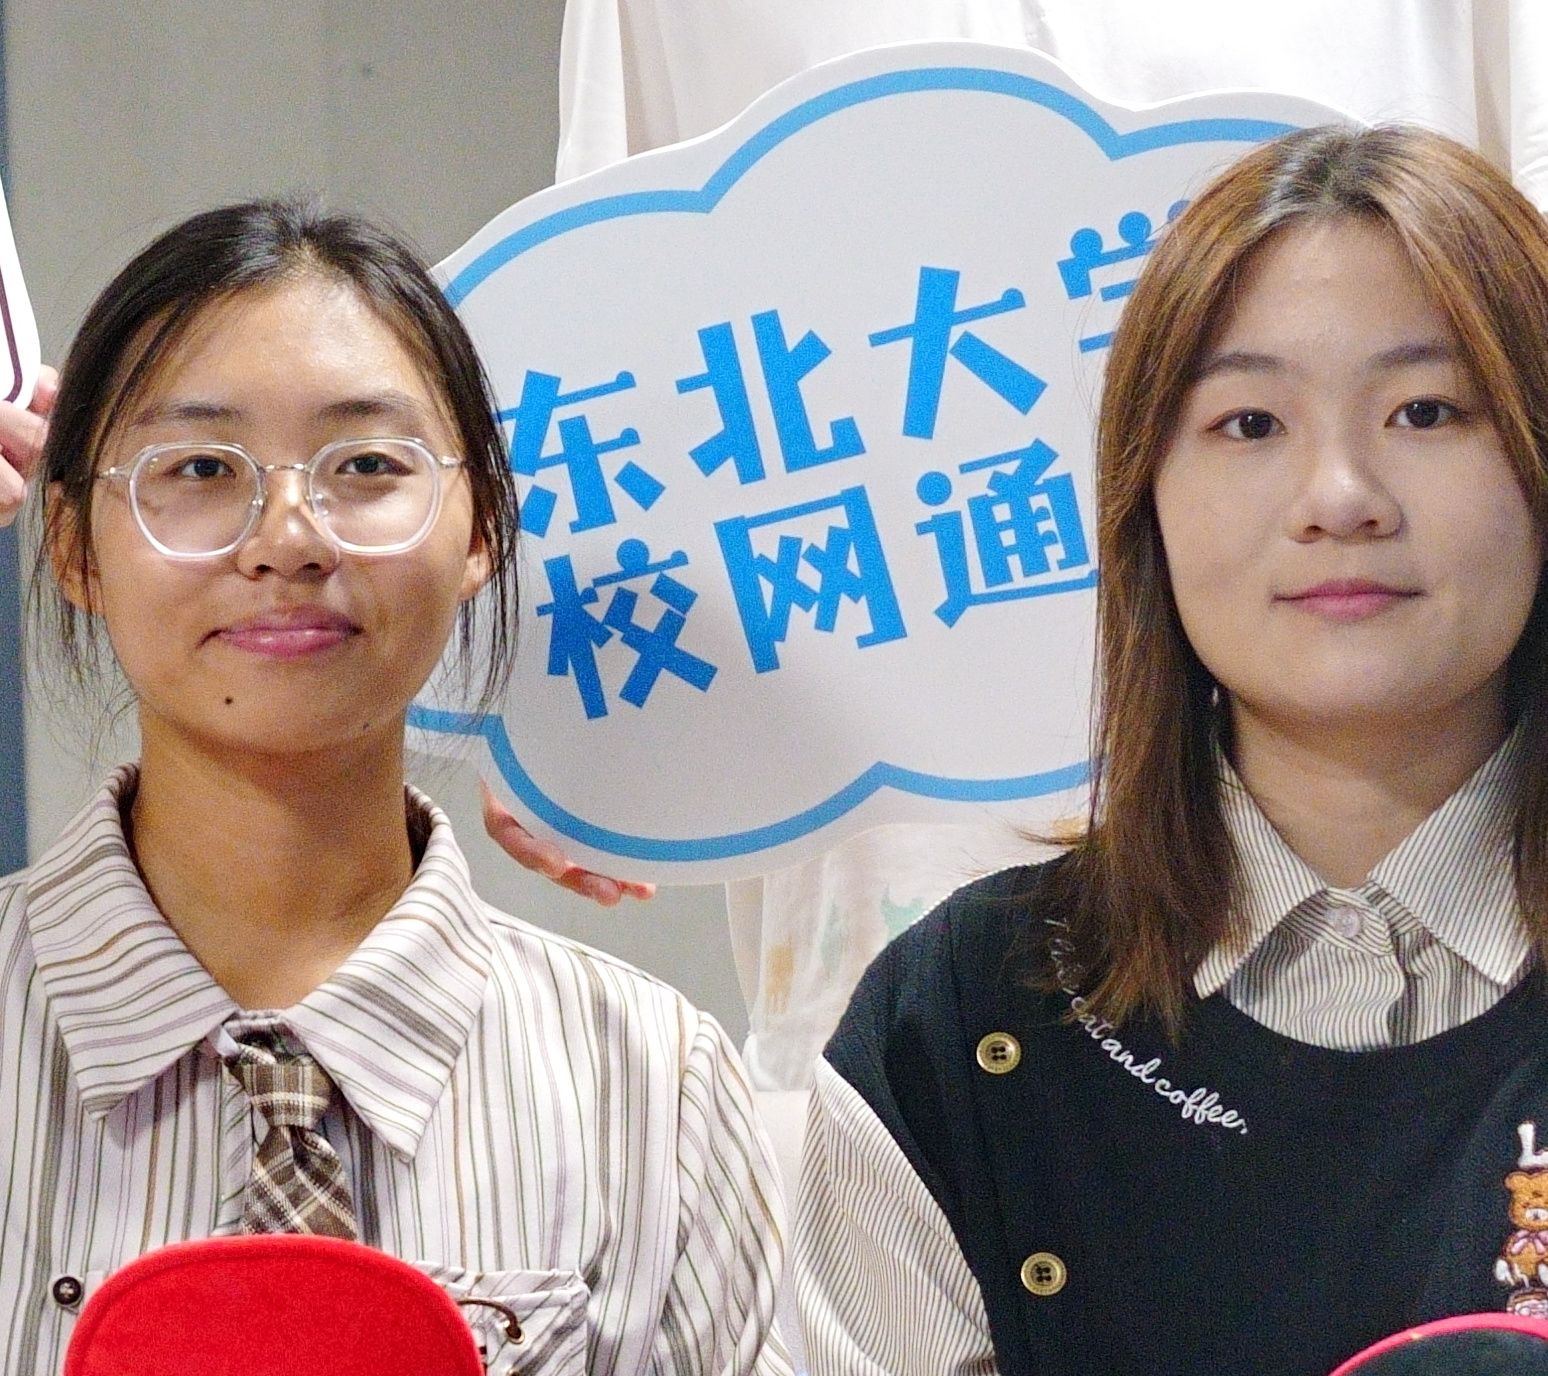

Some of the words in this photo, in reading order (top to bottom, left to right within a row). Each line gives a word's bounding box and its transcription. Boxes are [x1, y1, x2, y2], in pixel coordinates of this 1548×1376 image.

[536, 437, 1100, 720] 校网通
[1101, 1038, 1161, 1084] and
